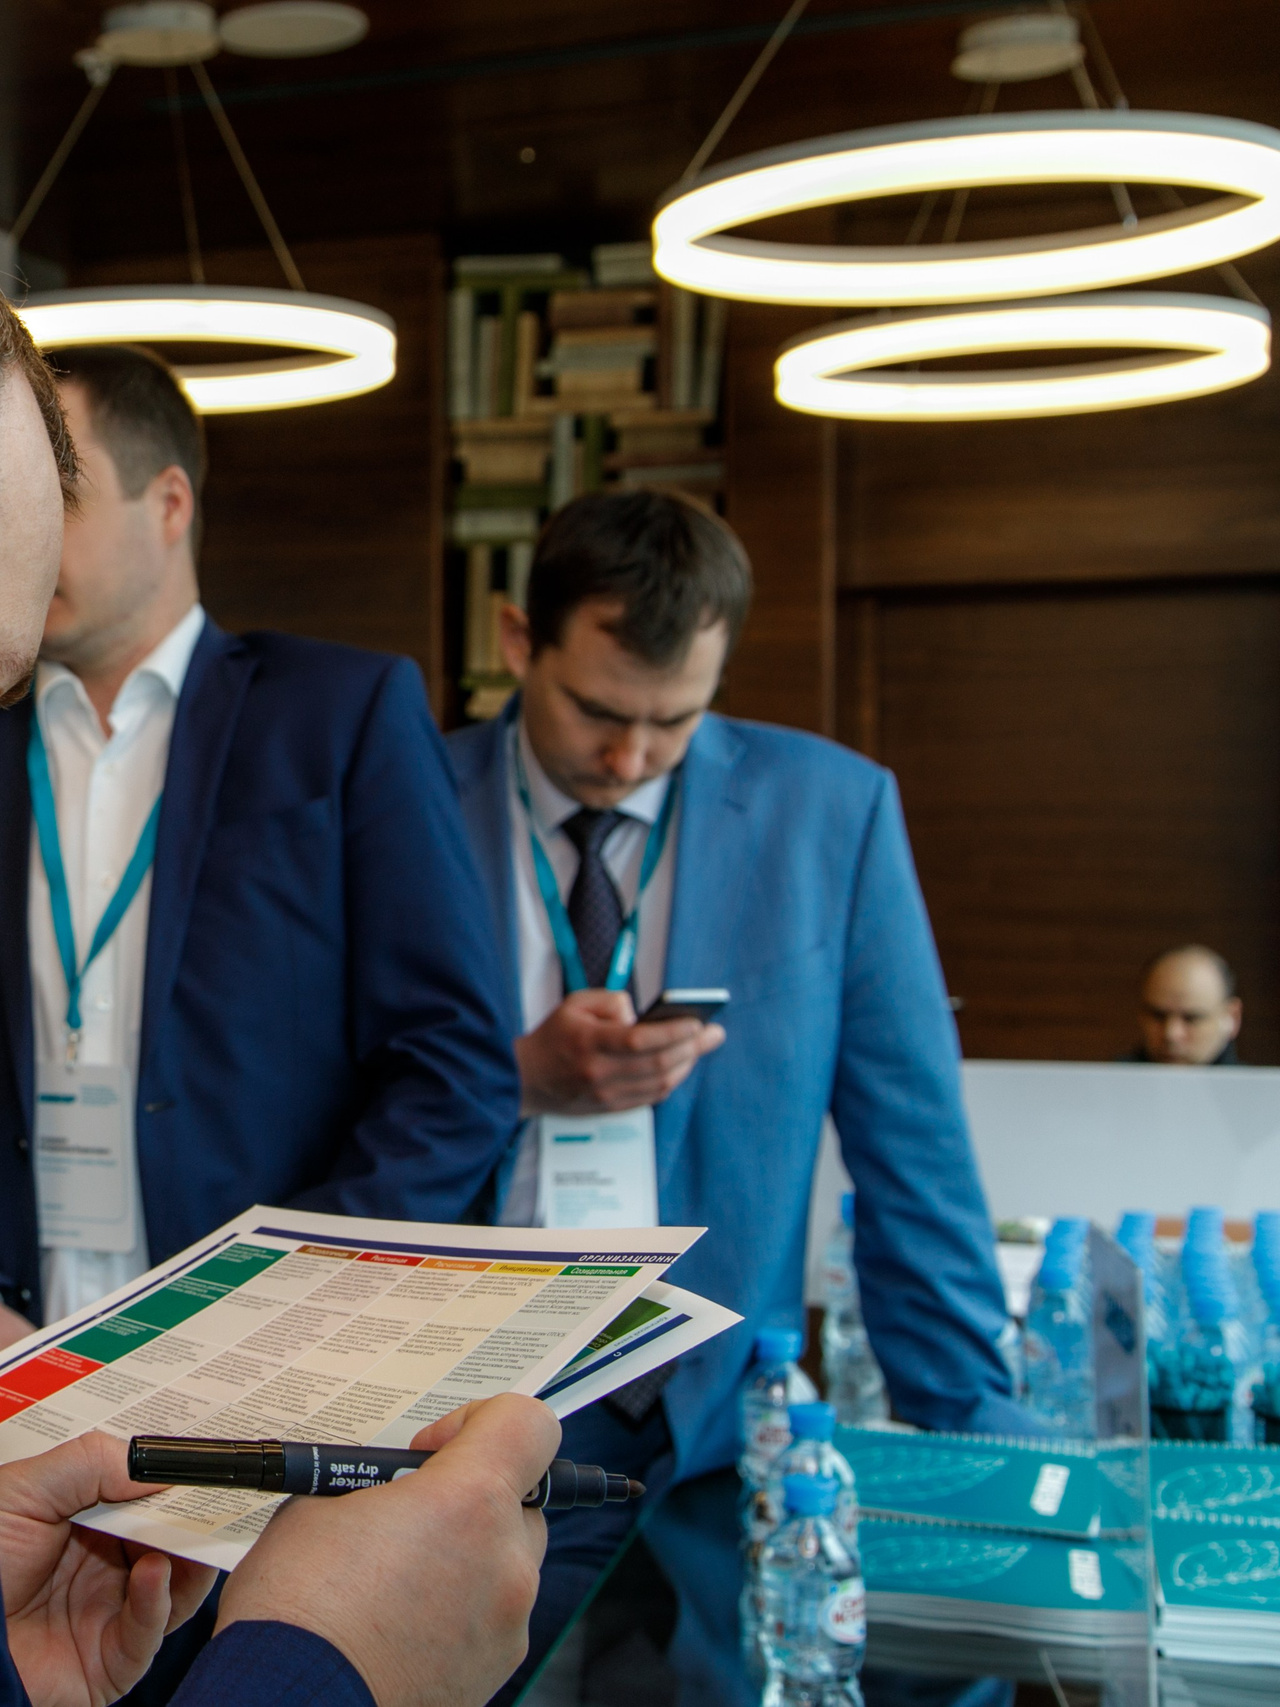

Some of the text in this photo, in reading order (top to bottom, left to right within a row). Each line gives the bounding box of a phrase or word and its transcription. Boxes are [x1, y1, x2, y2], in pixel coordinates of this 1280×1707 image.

[499, 1265, 551, 1273] Инициативная
[570, 1267, 629, 1276] Созидательная
[330, 1462, 379, 1478] dry safe
